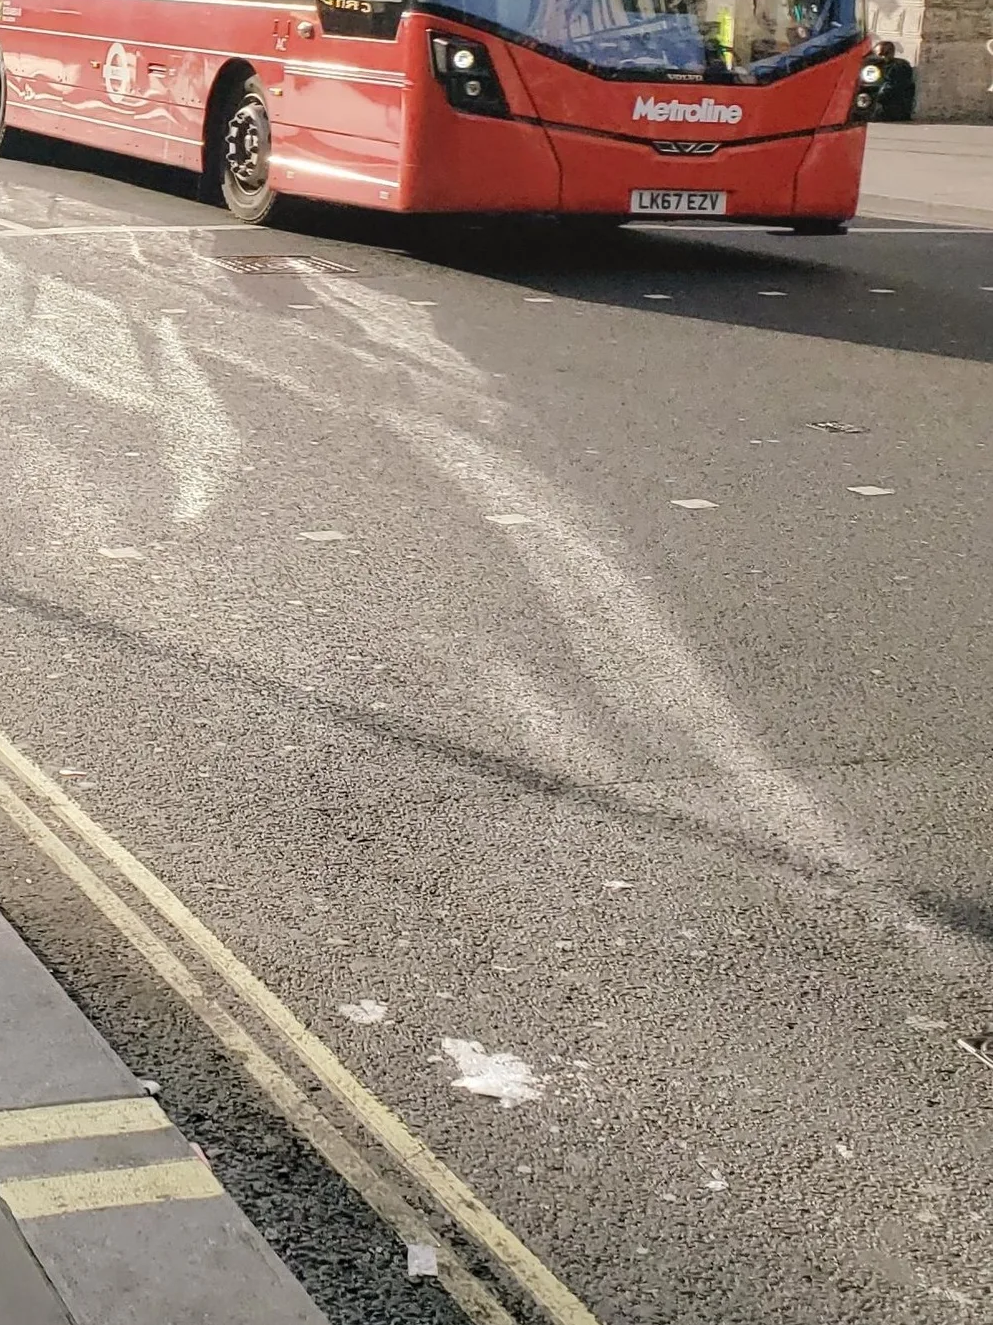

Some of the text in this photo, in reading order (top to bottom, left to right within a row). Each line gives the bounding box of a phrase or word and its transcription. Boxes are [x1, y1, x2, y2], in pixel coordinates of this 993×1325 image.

[632, 95, 743, 124] Metroline
[638, 192, 720, 211] LK67 EZV
